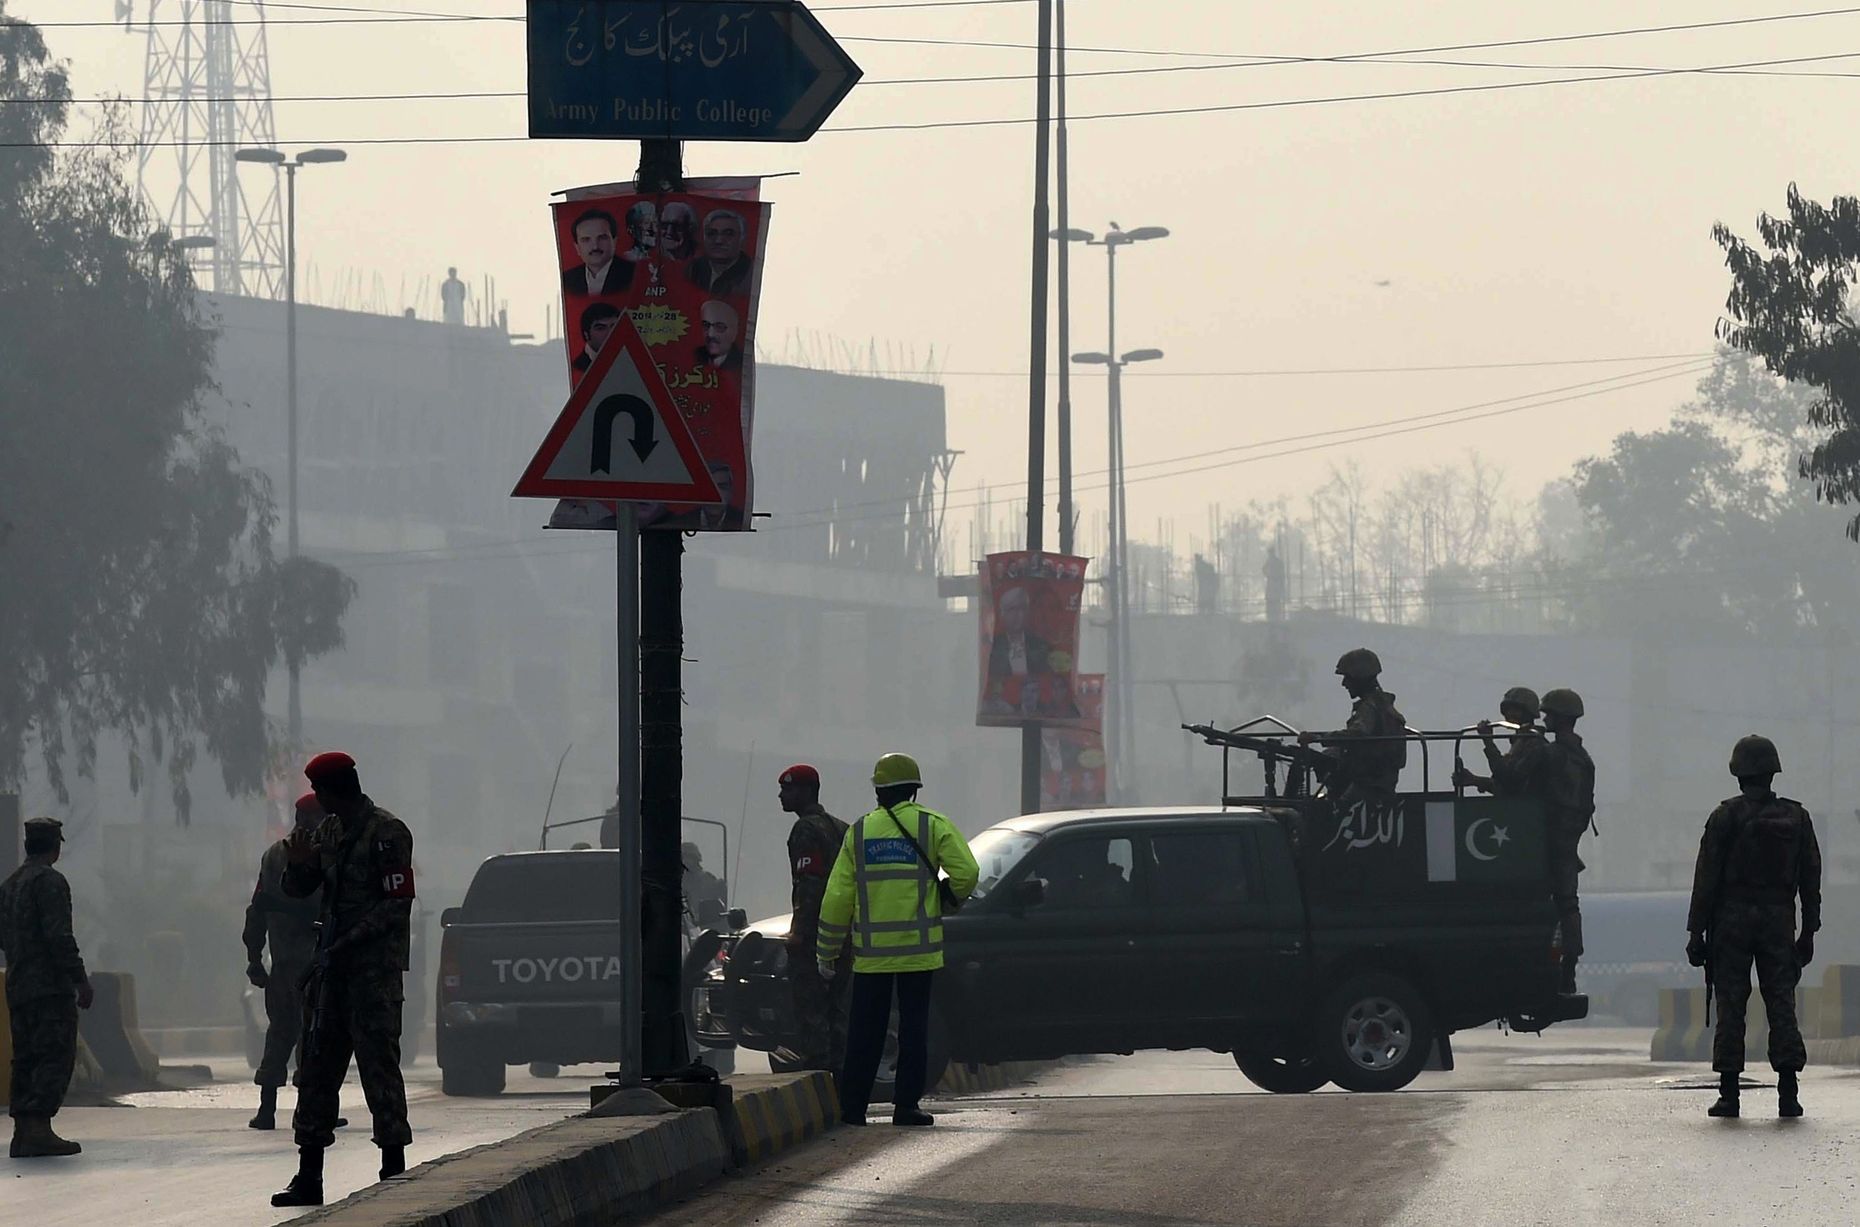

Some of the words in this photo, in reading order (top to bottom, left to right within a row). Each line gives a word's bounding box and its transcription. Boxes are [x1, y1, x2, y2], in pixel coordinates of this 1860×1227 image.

[544, 97, 599, 124] Army
[613, 97, 681, 122] Public
[696, 98, 773, 128] College
[644, 286, 667, 297] ANP
[491, 956, 621, 984] TOYOTA
